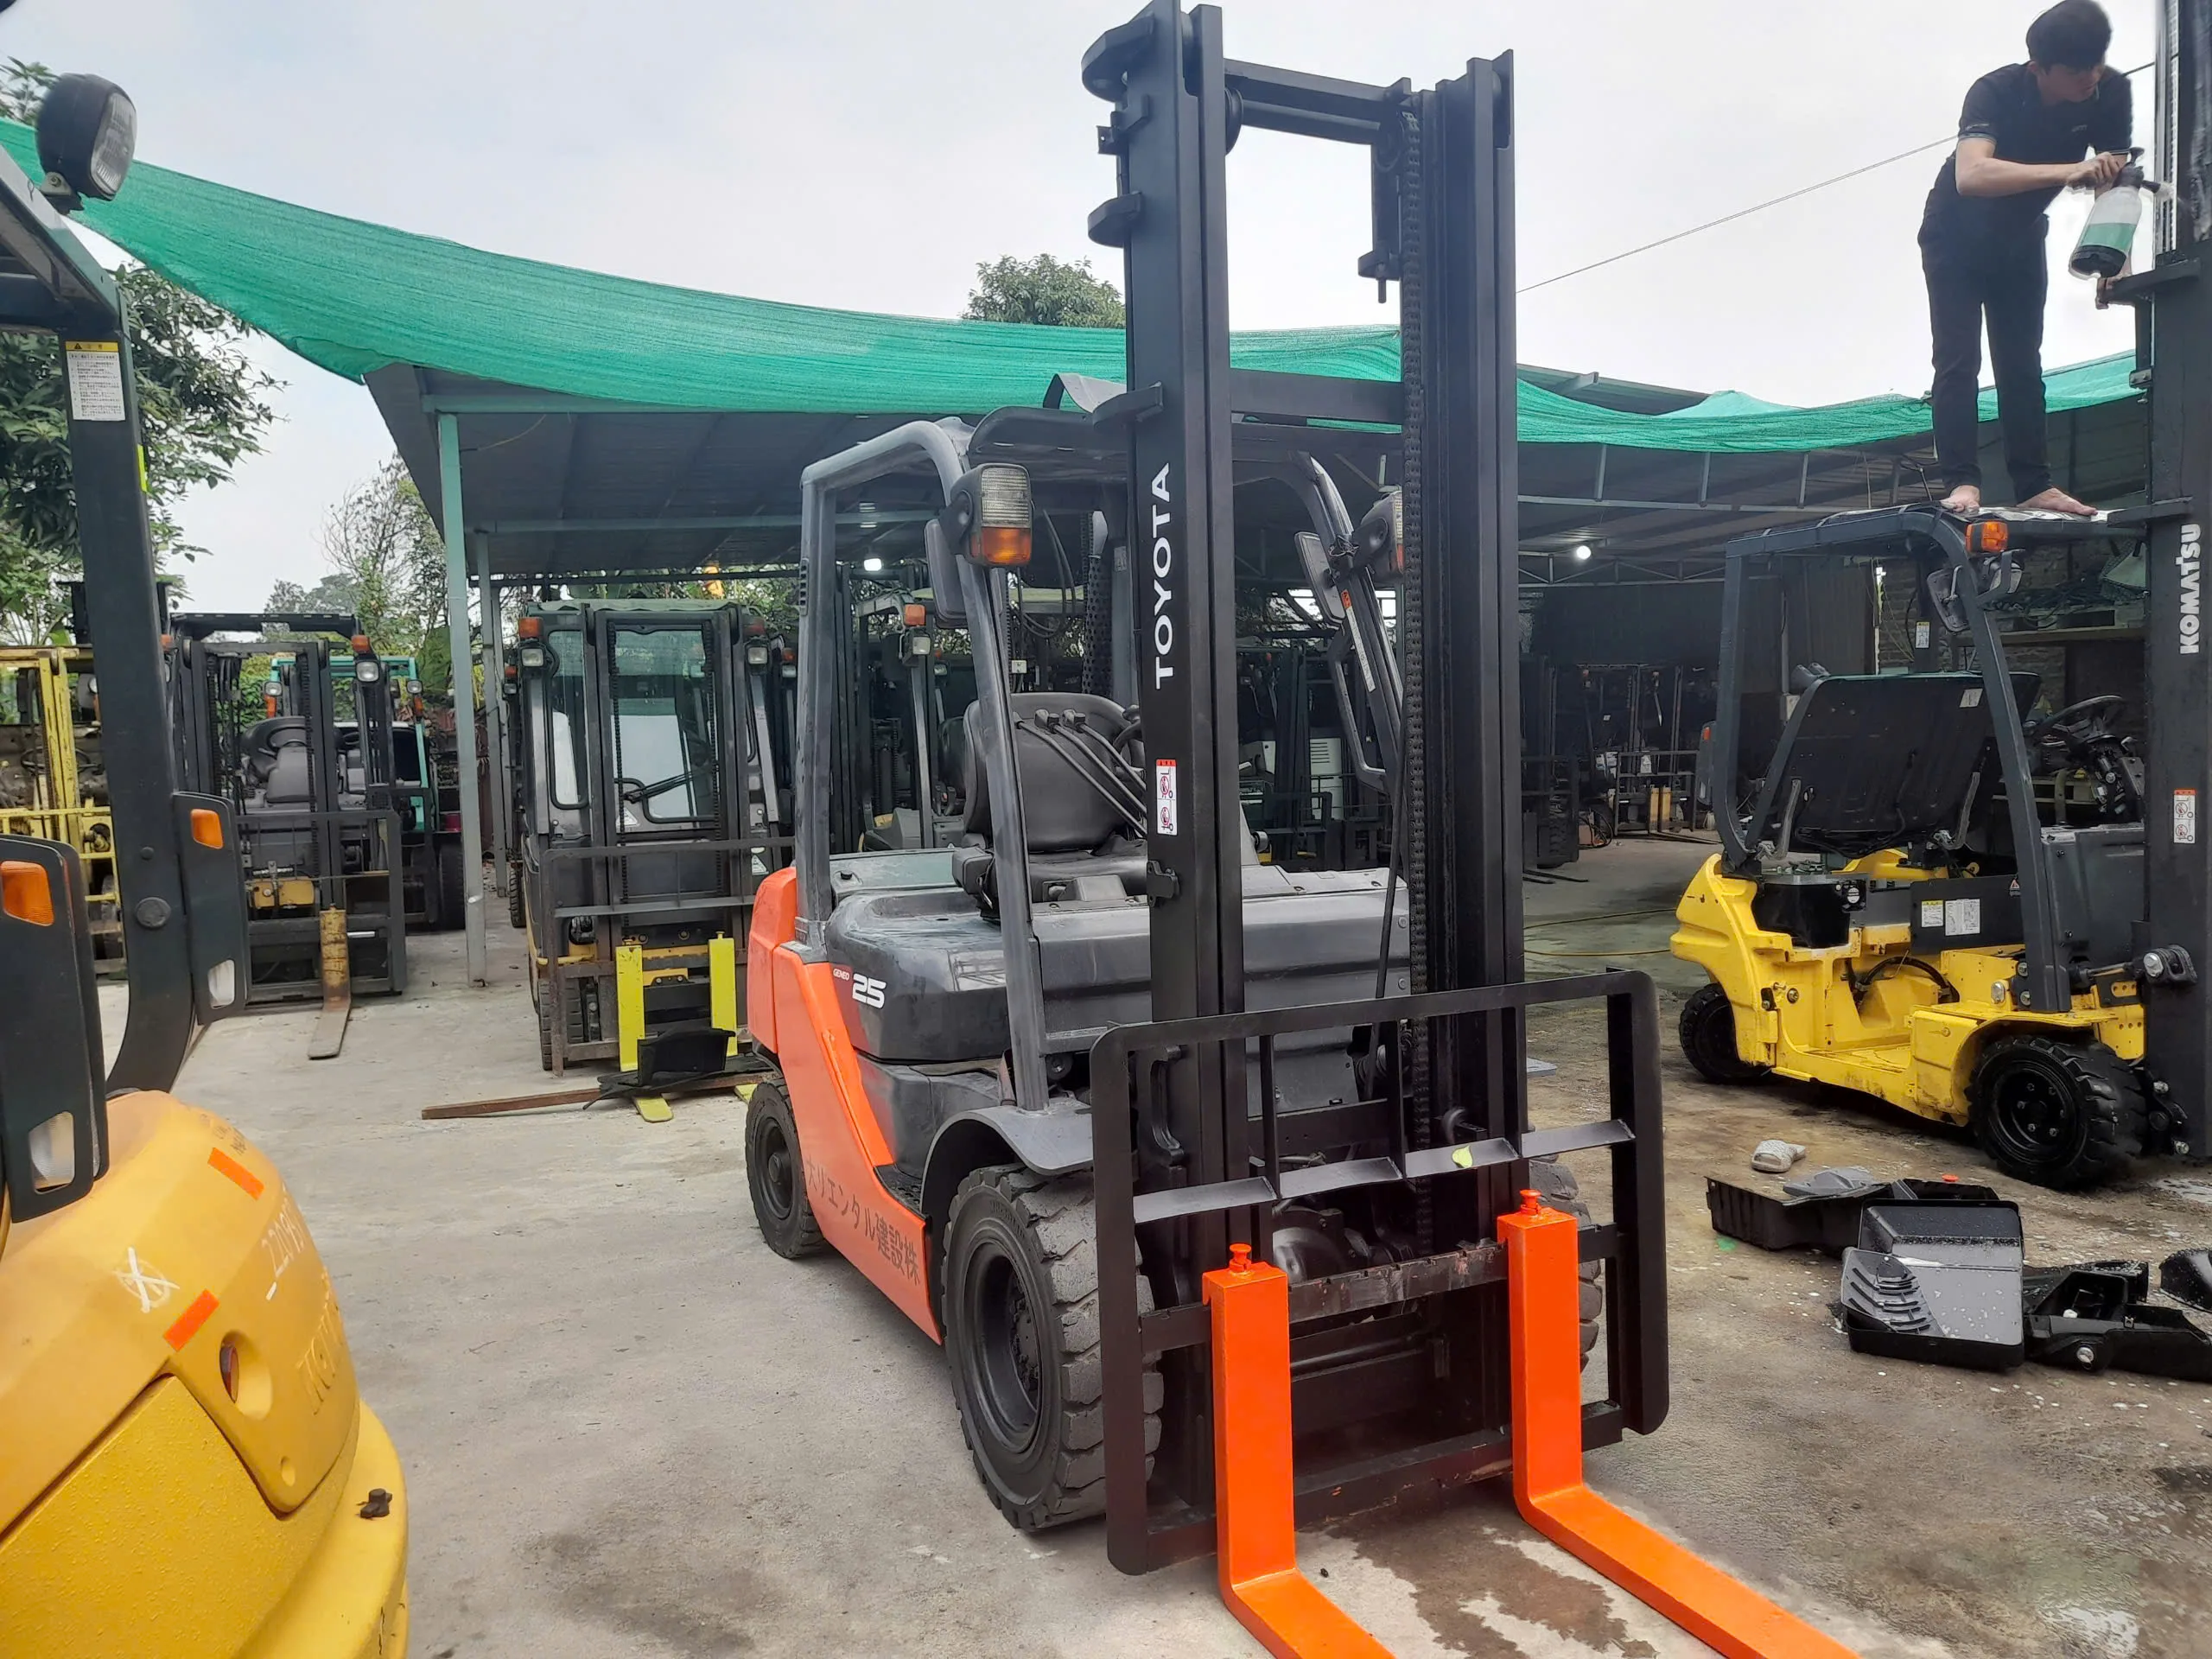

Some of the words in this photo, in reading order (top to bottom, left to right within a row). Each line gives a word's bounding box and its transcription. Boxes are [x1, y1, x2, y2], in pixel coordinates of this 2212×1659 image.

[1151, 462, 1173, 690] TOYOTA
[2175, 523, 2202, 655] KOMATSU
[832, 968, 850, 981] GENEO
[852, 973, 887, 1009] 25
